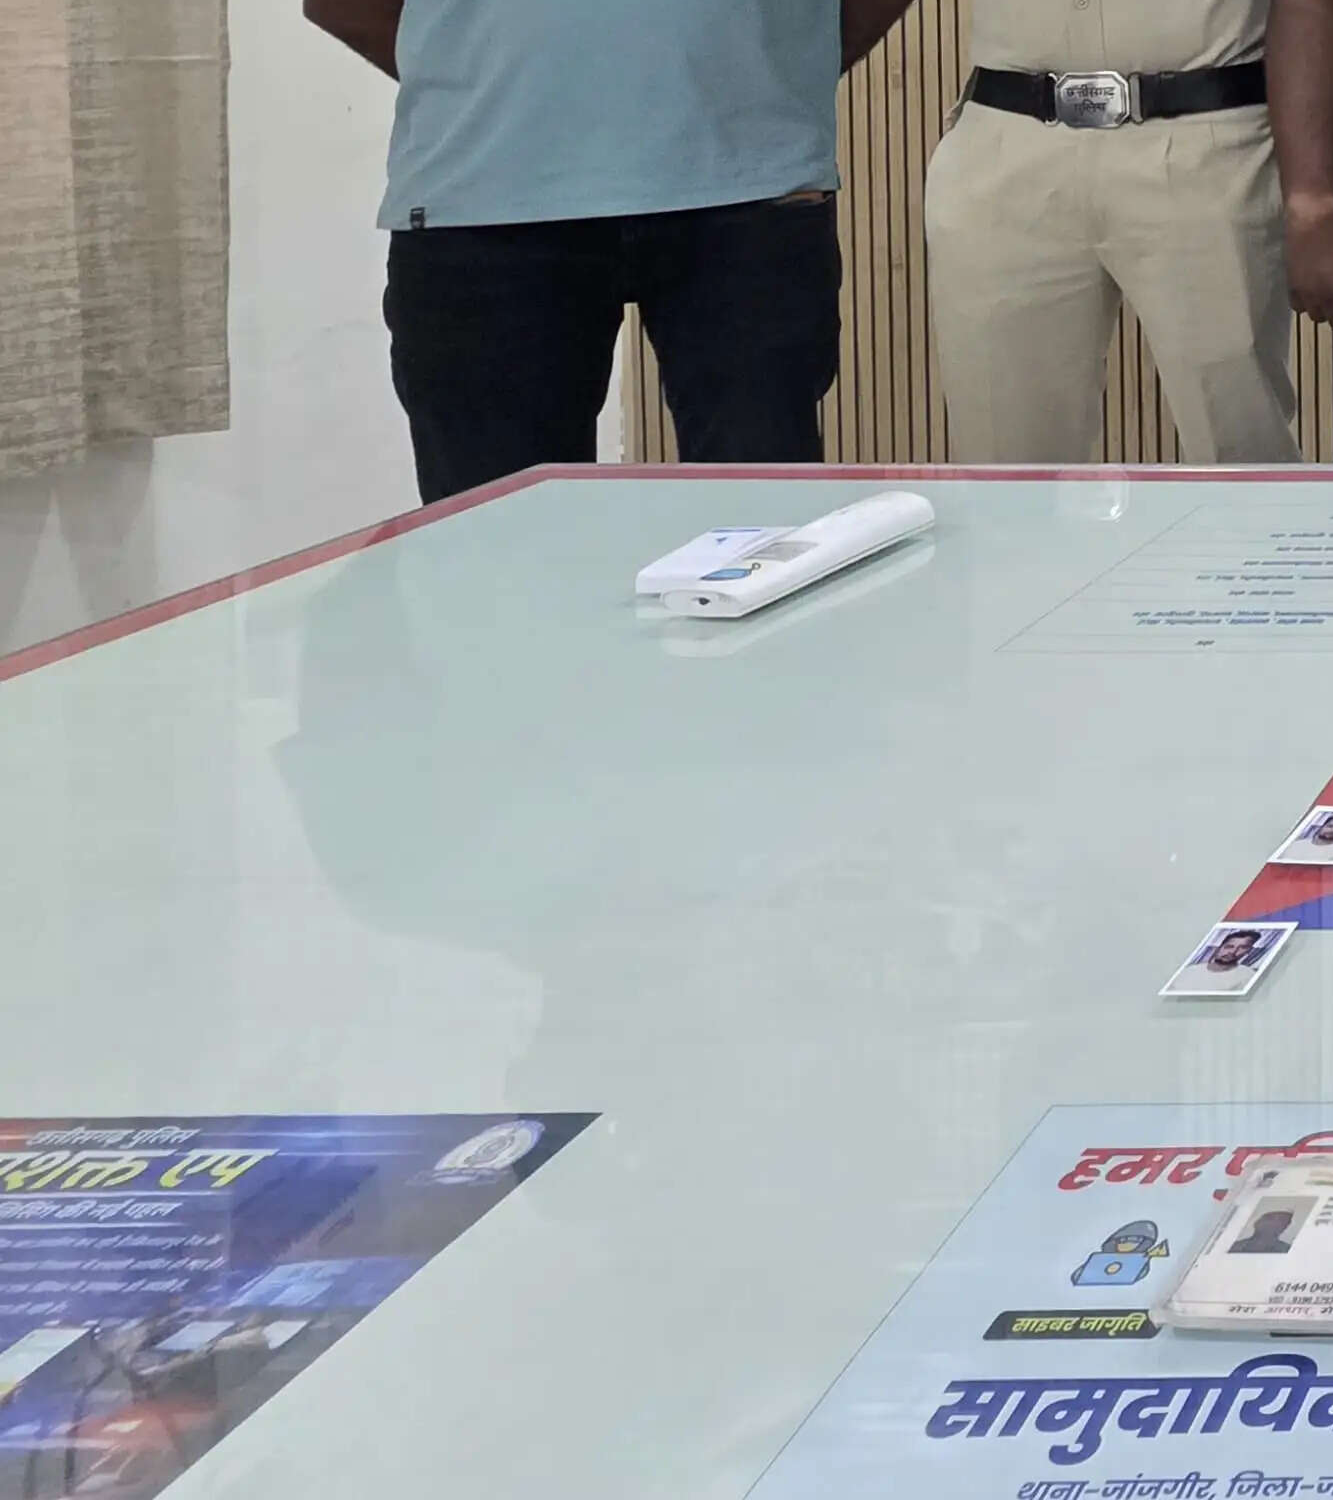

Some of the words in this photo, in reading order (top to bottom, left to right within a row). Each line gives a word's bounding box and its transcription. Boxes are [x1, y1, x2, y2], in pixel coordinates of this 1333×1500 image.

[1057, 1146, 1227, 1191] हमर
[1275, 1282, 1308, 1294] 6144
[1011, 1315, 1080, 1334] साइबर
[1077, 1312, 1149, 1335] जागृति
